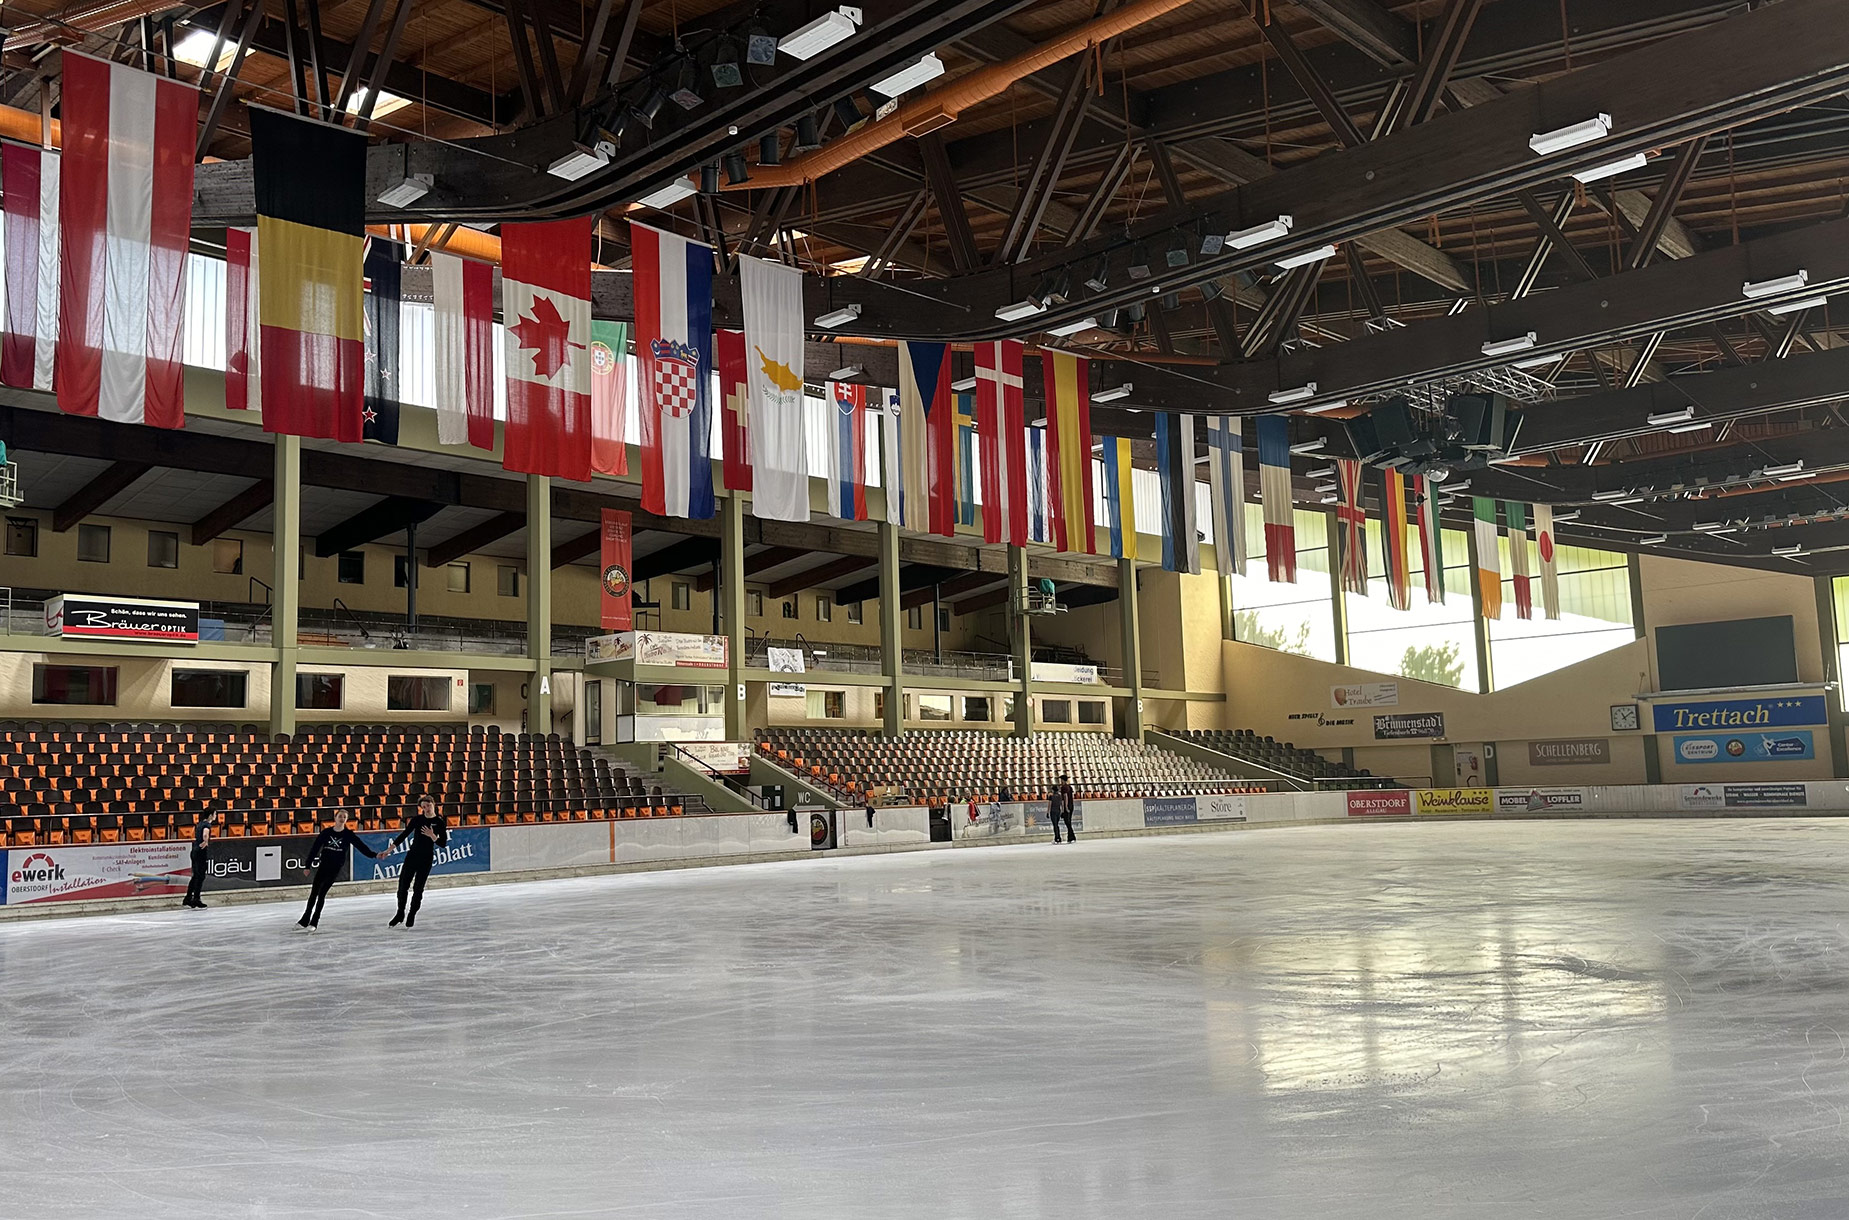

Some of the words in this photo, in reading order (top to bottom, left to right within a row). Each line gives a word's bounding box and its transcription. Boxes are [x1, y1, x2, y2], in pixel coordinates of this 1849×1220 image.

[111, 608, 131, 616] Schön,
[71, 610, 160, 631] Bräuer
[540, 676, 551, 695] A
[1345, 686, 1362, 697] Hotel
[737, 684, 746, 701] B
[1138, 700, 1144, 712] B
[1347, 697, 1372, 706] Traube
[1674, 704, 1770, 728] Trettach
[1484, 746, 1494, 758] D
[797, 792, 811, 803] WC
[1350, 799, 1407, 808] OBERSTDORF
[1419, 791, 1489, 808] Weinklause
[1211, 801, 1232, 813] Store
[11, 864, 65, 883] ewerk
[205, 858, 252, 877] llgäu
[11, 886, 48, 894] OBERSTDORF
[49, 876, 107, 894] Installation
